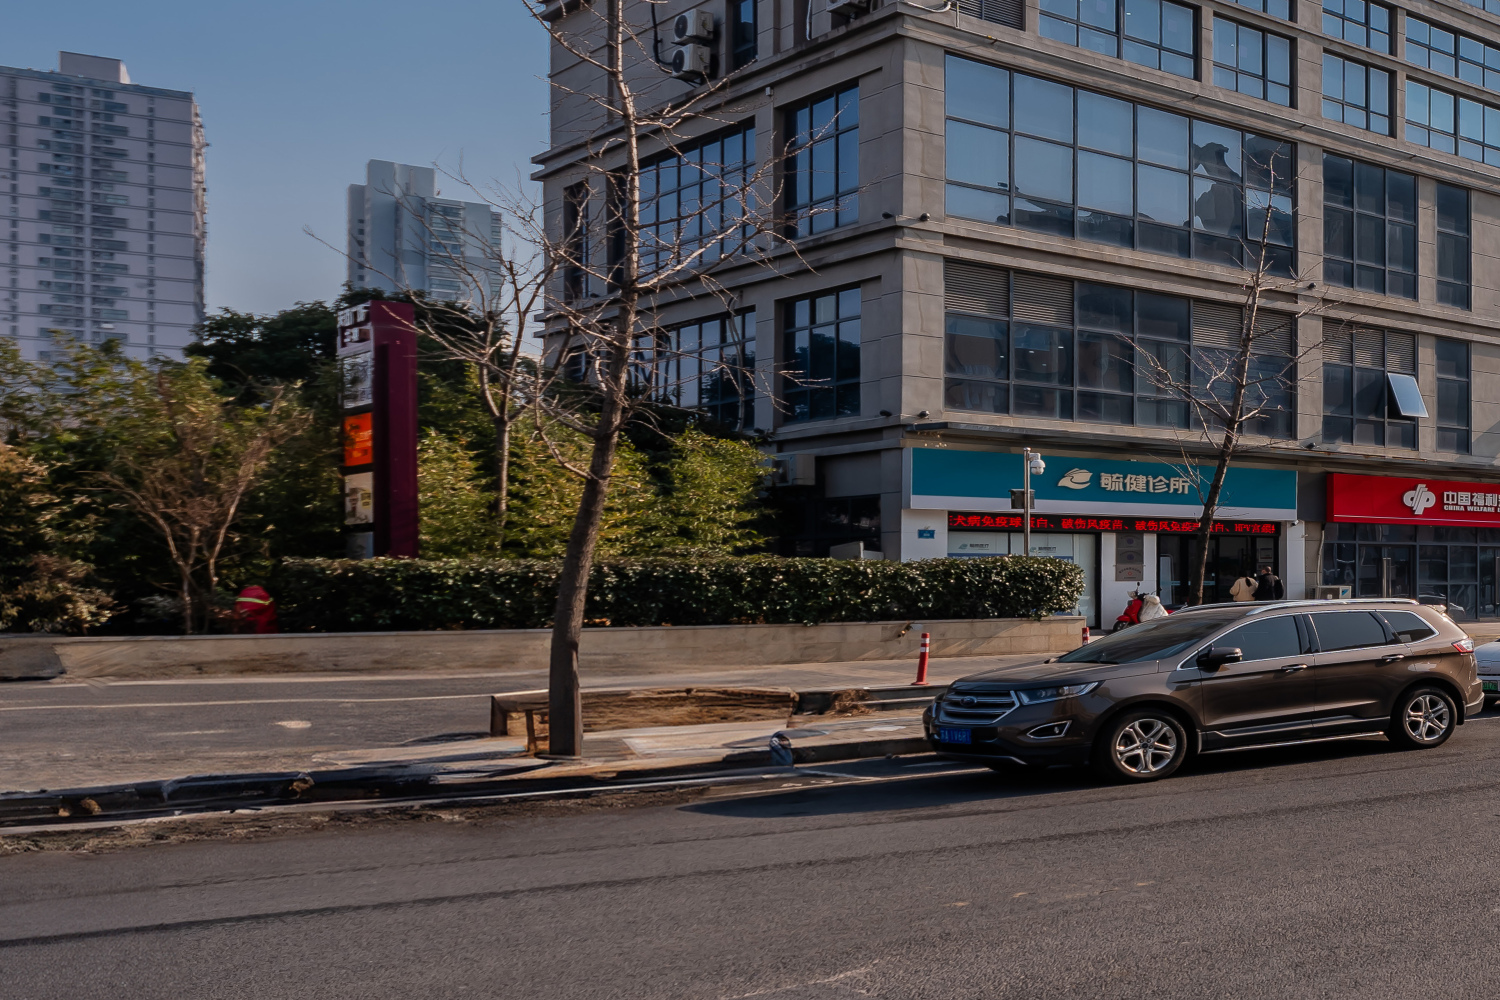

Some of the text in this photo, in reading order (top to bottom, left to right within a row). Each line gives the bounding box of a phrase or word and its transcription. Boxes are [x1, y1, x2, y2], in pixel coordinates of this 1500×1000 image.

[1100, 472, 1190, 495] 毓健诊所
[1467, 505, 1495, 513] WELFARE
